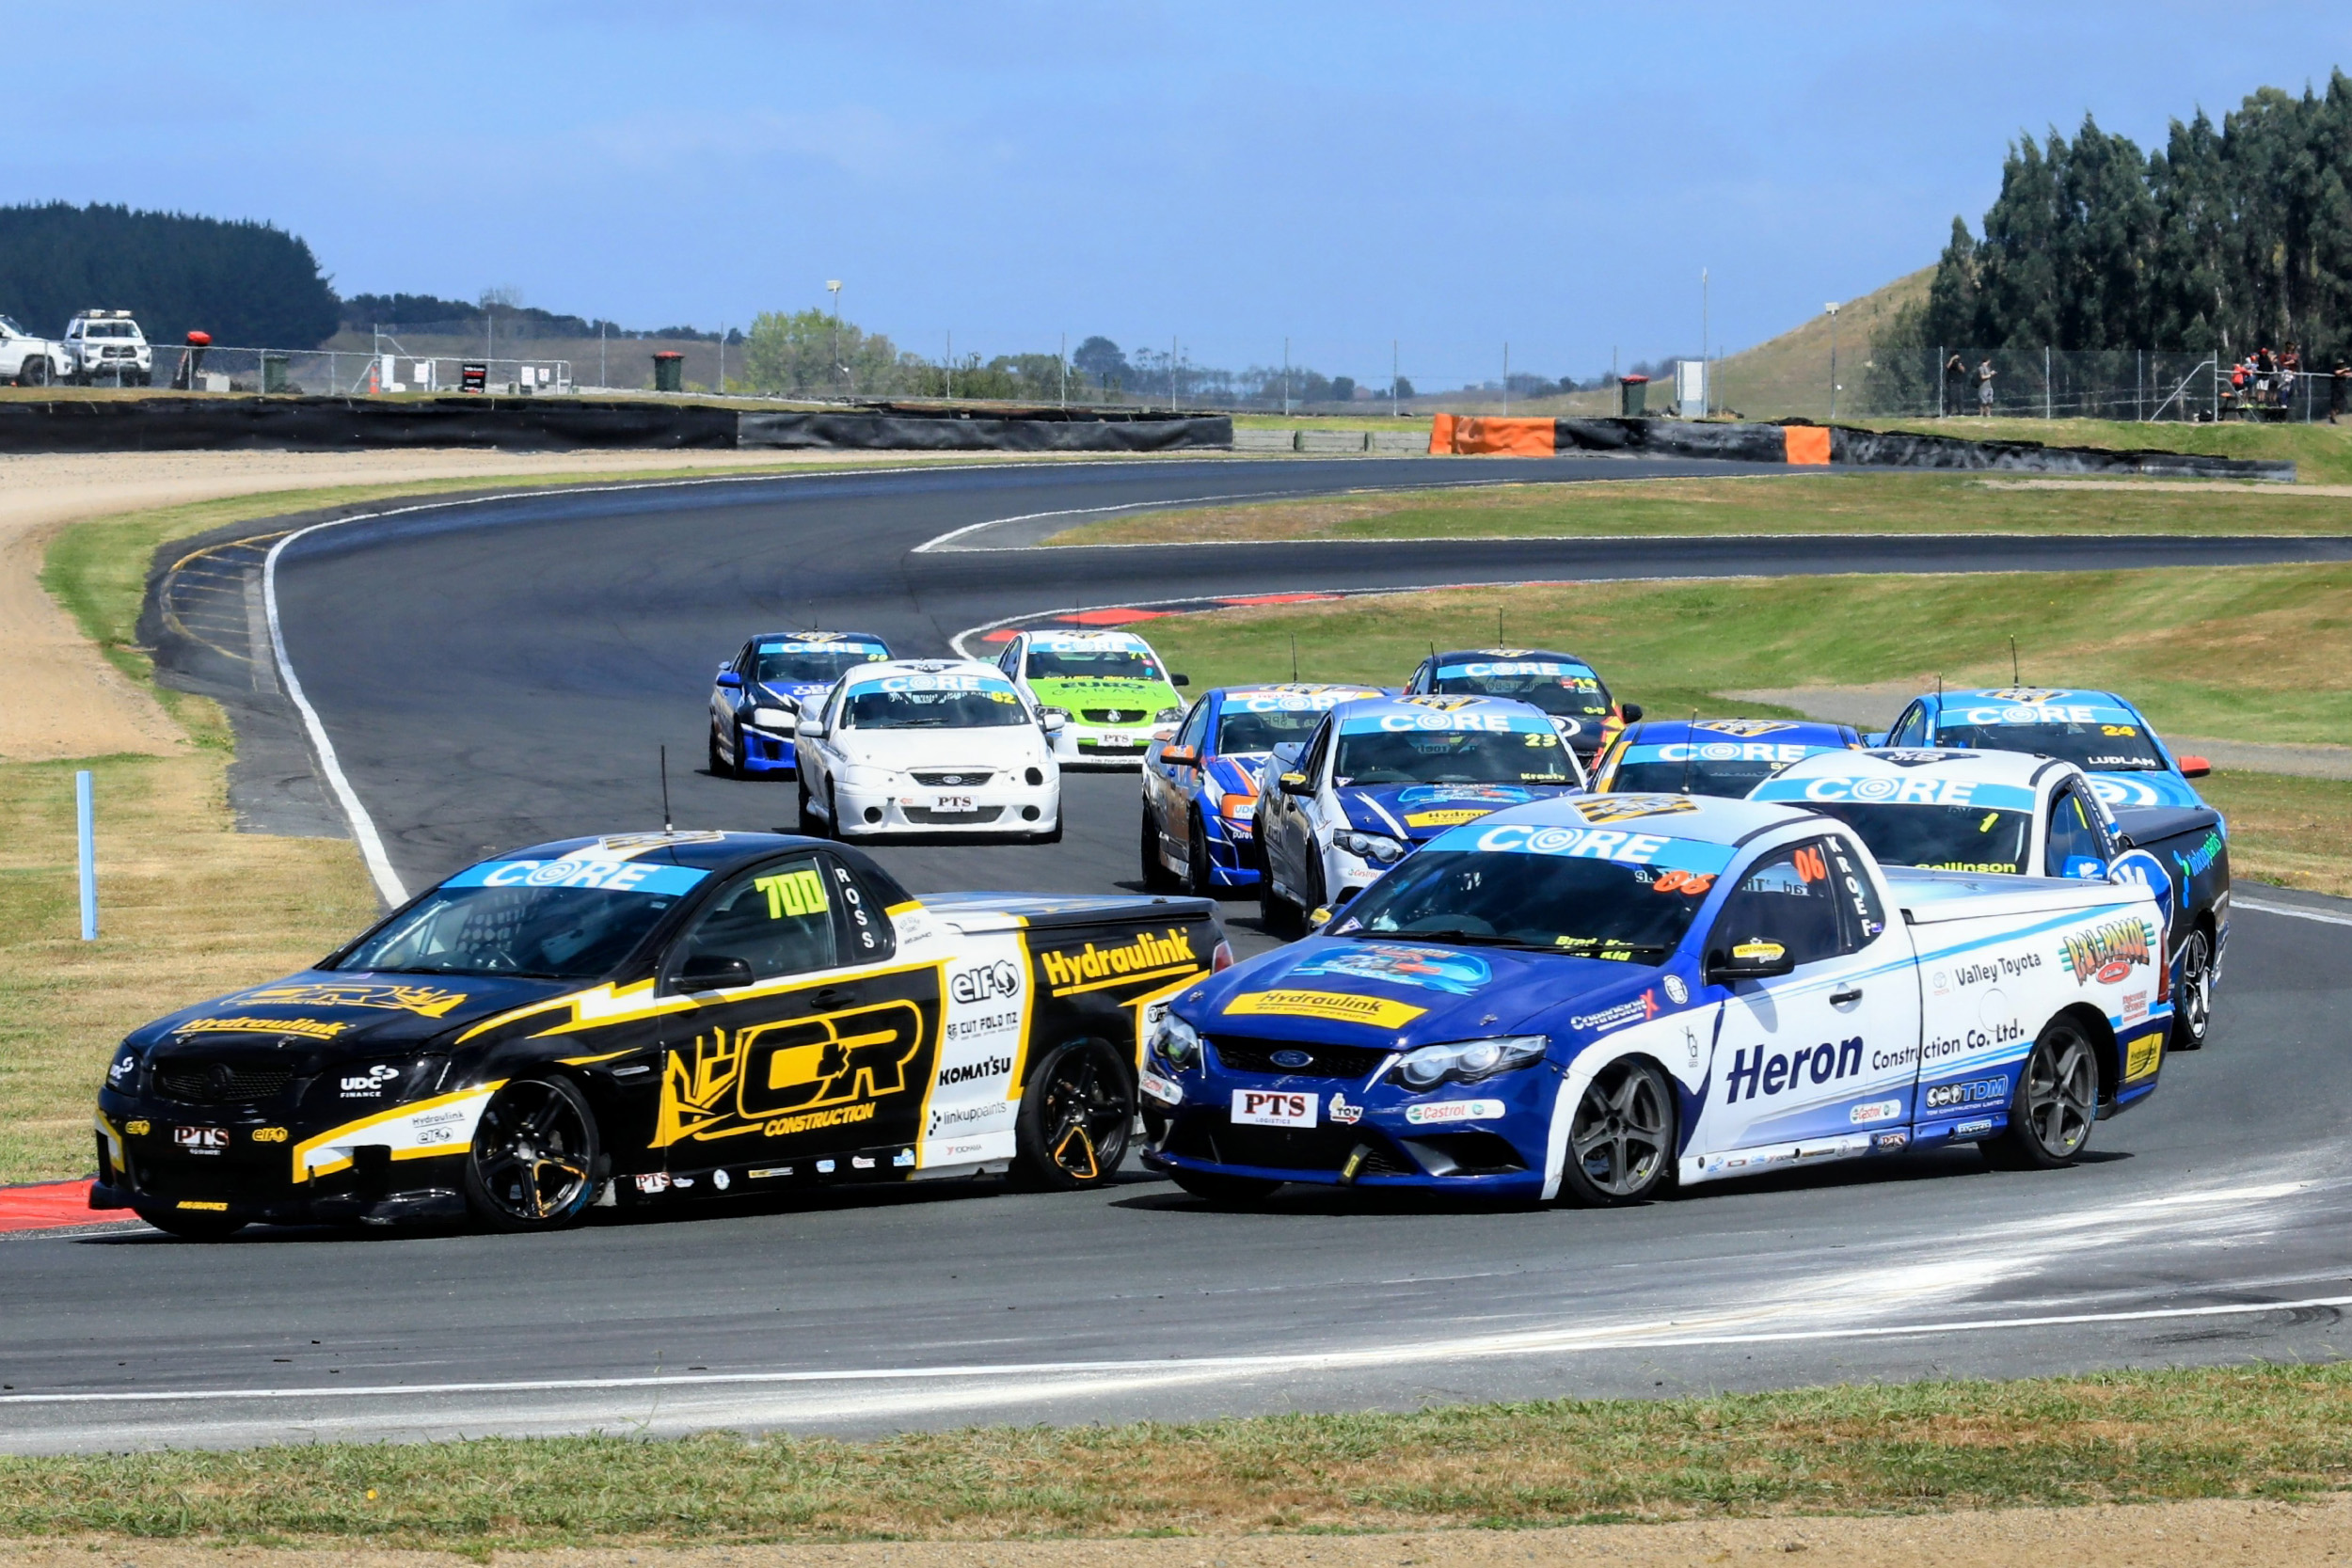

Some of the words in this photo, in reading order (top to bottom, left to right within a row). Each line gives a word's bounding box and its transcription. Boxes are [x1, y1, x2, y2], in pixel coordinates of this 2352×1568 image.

[782, 642, 864, 654] CORE
[1051, 641, 1127, 651] CORE
[1465, 662, 1561, 676] CORE
[881, 674, 981, 691] CORE
[991, 691, 1017, 705] 82
[1247, 697, 1340, 712] COR
[1380, 714, 1511, 732] CORE
[1967, 706, 2097, 723] CORE
[1104, 734, 1129, 742] PTS
[1525, 734, 1557, 747] 23
[2101, 725, 2137, 736] 24
[1659, 742, 1806, 763] CORE
[2088, 755, 2156, 767] LUDLAM
[1805, 777, 1979, 805] CORE
[937, 797, 971, 806] PTS
[1979, 812, 1999, 833] 1
[1477, 825, 1671, 864] CORE
[1353, 869, 1379, 879] Castrol
[1795, 847, 1826, 883] 06
[483, 859, 659, 892] CORE
[1653, 870, 1715, 895] 06
[754, 870, 828, 919] 700
[1826, 836, 1872, 937] KROEF
[834, 867, 876, 949] ROSS
[1041, 927, 1196, 985] Hydraulink
[1600, 951, 1632, 961] Kid
[1955, 964, 1998, 987] Valley
[1997, 953, 2042, 976] Toyota
[1259, 992, 1383, 1013] Hydraulink
[960, 1020, 977, 1034] CUT
[980, 1014, 1003, 1031] FOLD
[1318, 1009, 1368, 1020] pressure
[180, 1016, 349, 1037] Hydraulink
[1872, 1036, 1961, 1070] Construction
[1966, 1029, 1991, 1049] Co.
[1996, 1018, 2025, 1043] Ltd.
[939, 1055, 1011, 1086] KOMATSU
[1725, 1036, 1864, 1105] Heron
[341, 1076, 382, 1091] UDC
[1961, 1077, 2006, 1101] TDM
[944, 1101, 1007, 1125] linkuppaints
[1244, 1094, 1306, 1117] PTS
[1337, 1107, 1360, 1117] TOW
[1423, 1105, 1466, 1119] Castrol
[1939, 1103, 1981, 1114] CONSTRUCTION
[1982, 1099, 2004, 1108] LIMITED
[411, 1111, 465, 1126] Hydraulink
[764, 1102, 876, 1136] CONSTRUCTION
[177, 1127, 230, 1148] PTS
[635, 1171, 671, 1190] PTS
